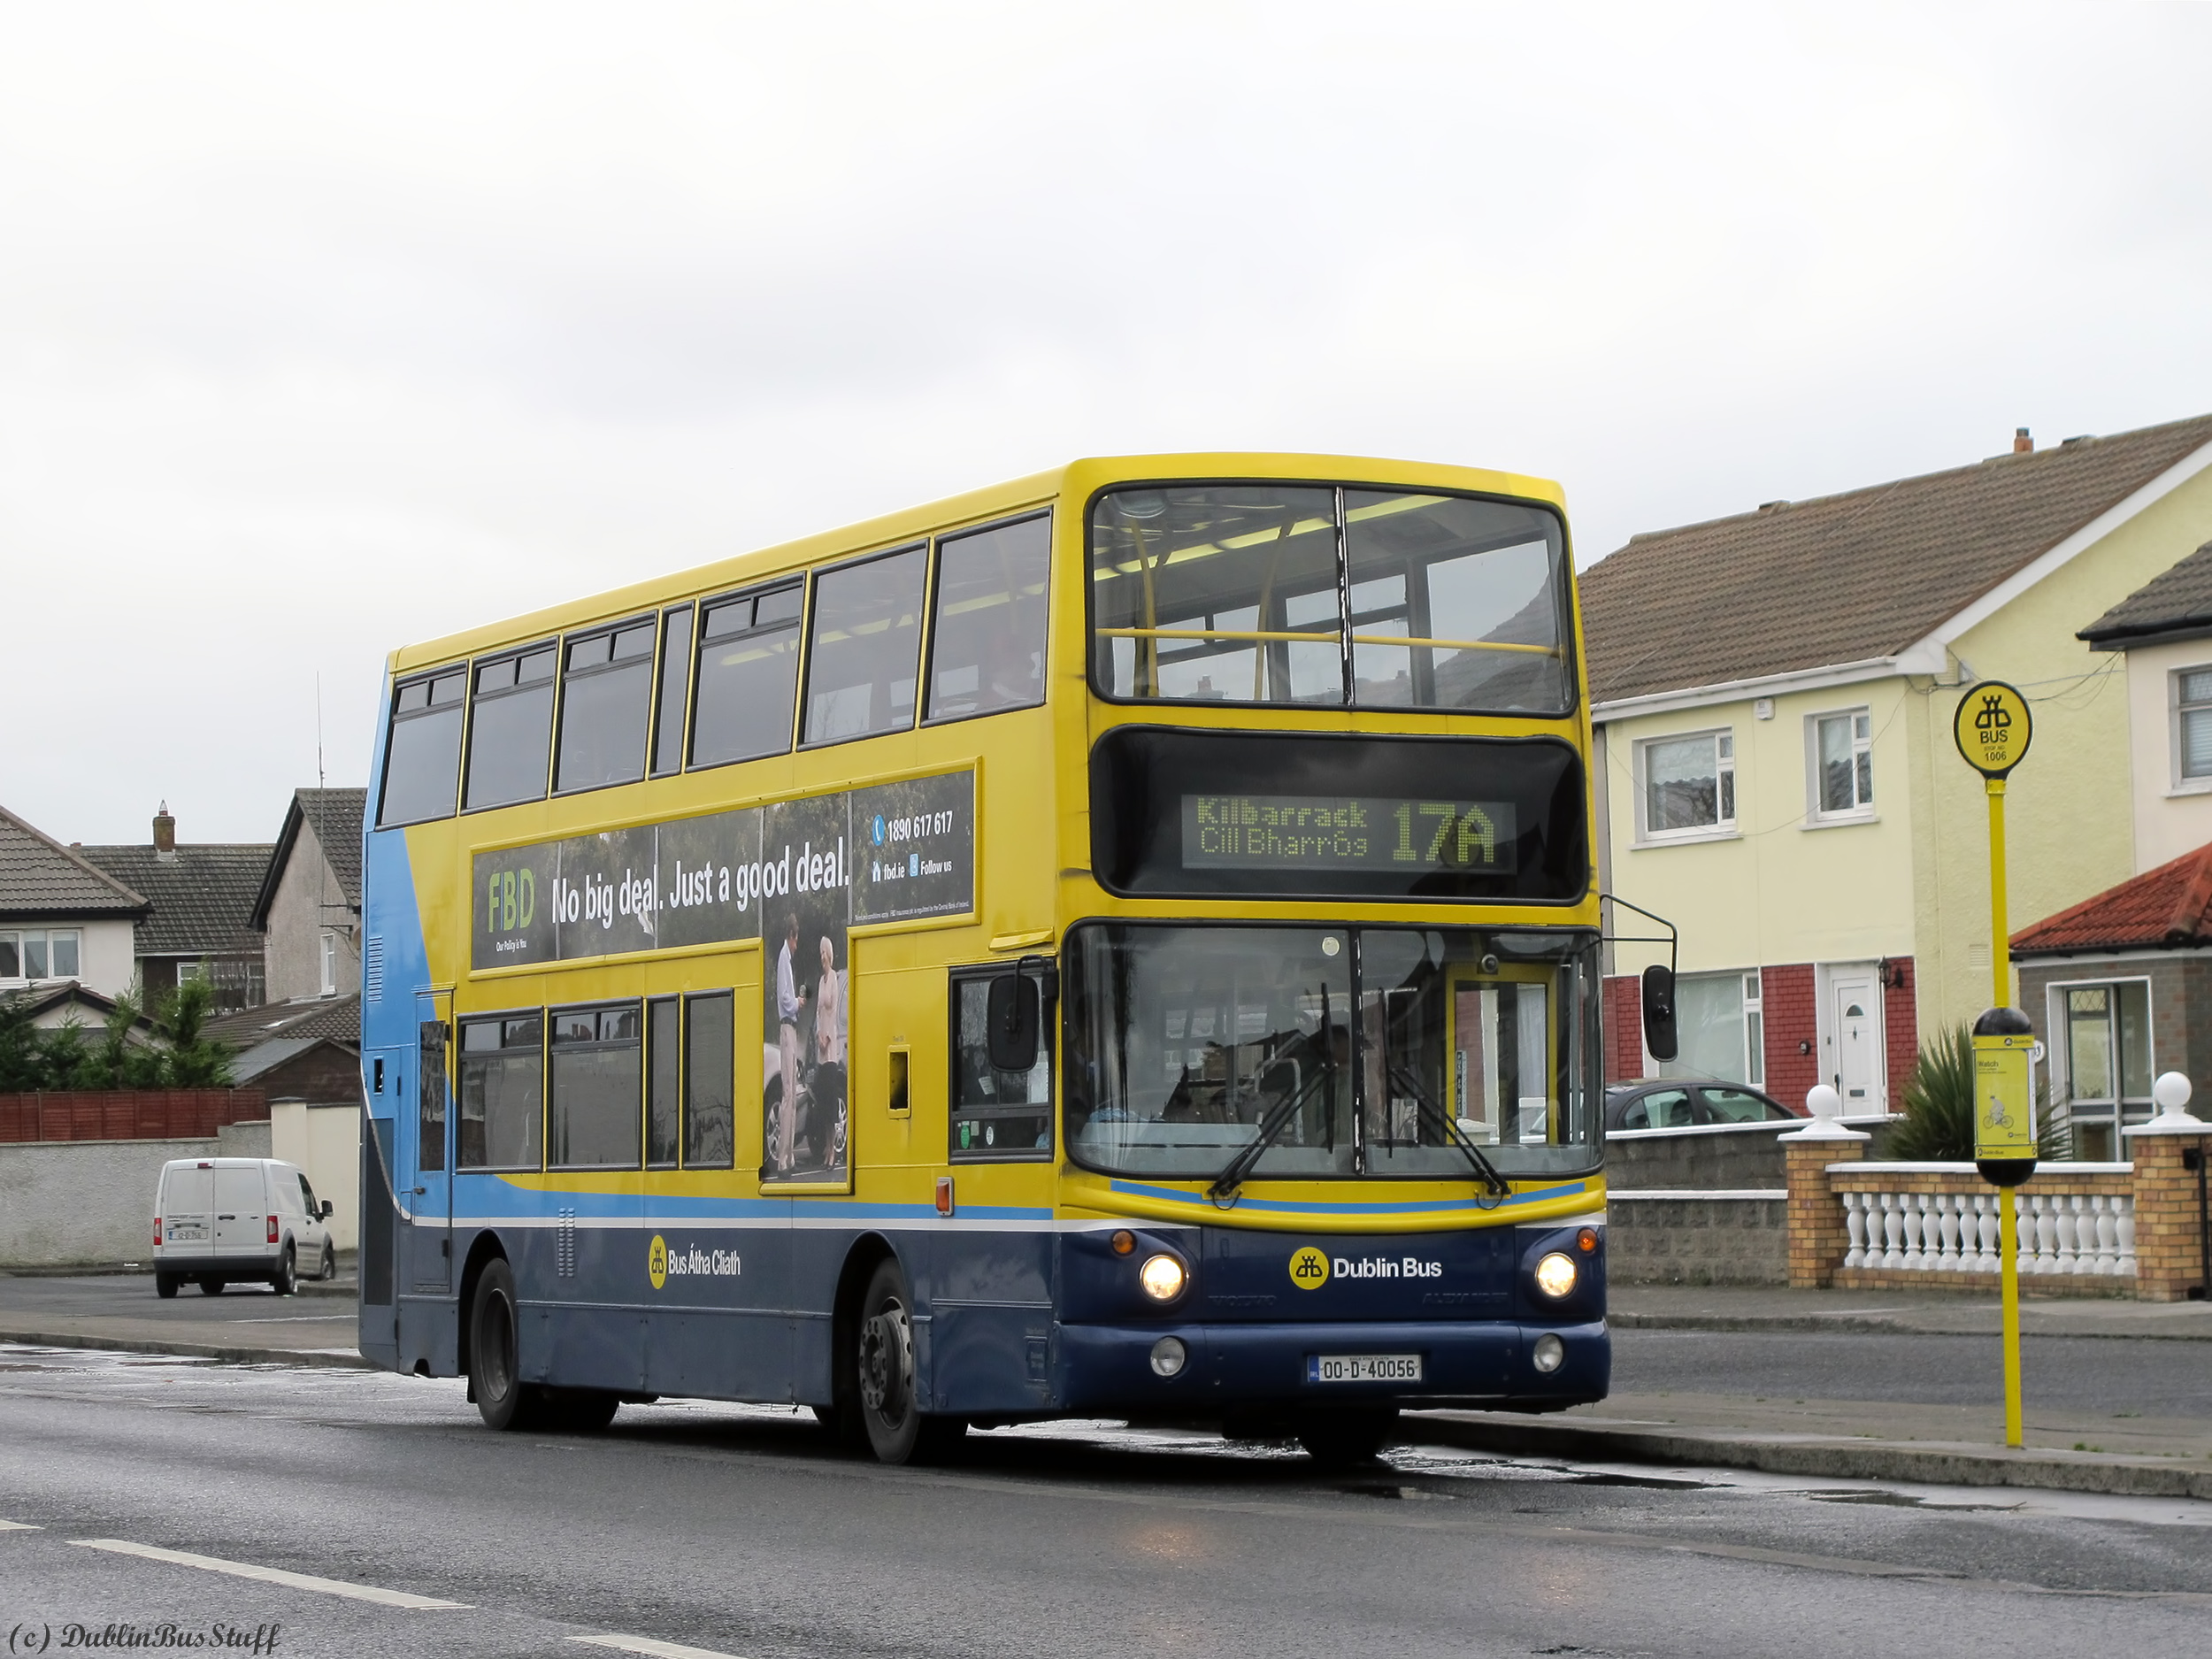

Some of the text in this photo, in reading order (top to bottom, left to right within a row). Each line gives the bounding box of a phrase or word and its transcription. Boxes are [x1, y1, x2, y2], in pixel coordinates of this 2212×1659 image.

[1980, 729, 2008, 743] BUS
[1985, 751, 2006, 761] 1006
[887, 810, 953, 842] 1890 617 617
[1198, 797, 1495, 863] Kilbarrack 17A
[1201, 826, 1239, 854] Cill
[552, 836, 849, 930] No big deal. Just a good deal.
[884, 859, 953, 880] fbd.ie Follow us
[488, 868, 534, 933] FBD
[668, 1243, 741, 1275] Bus Átha Cliath
[1333, 1257, 1442, 1278] Dublin Bus
[1325, 1360, 1415, 1379] 00-D-40056
